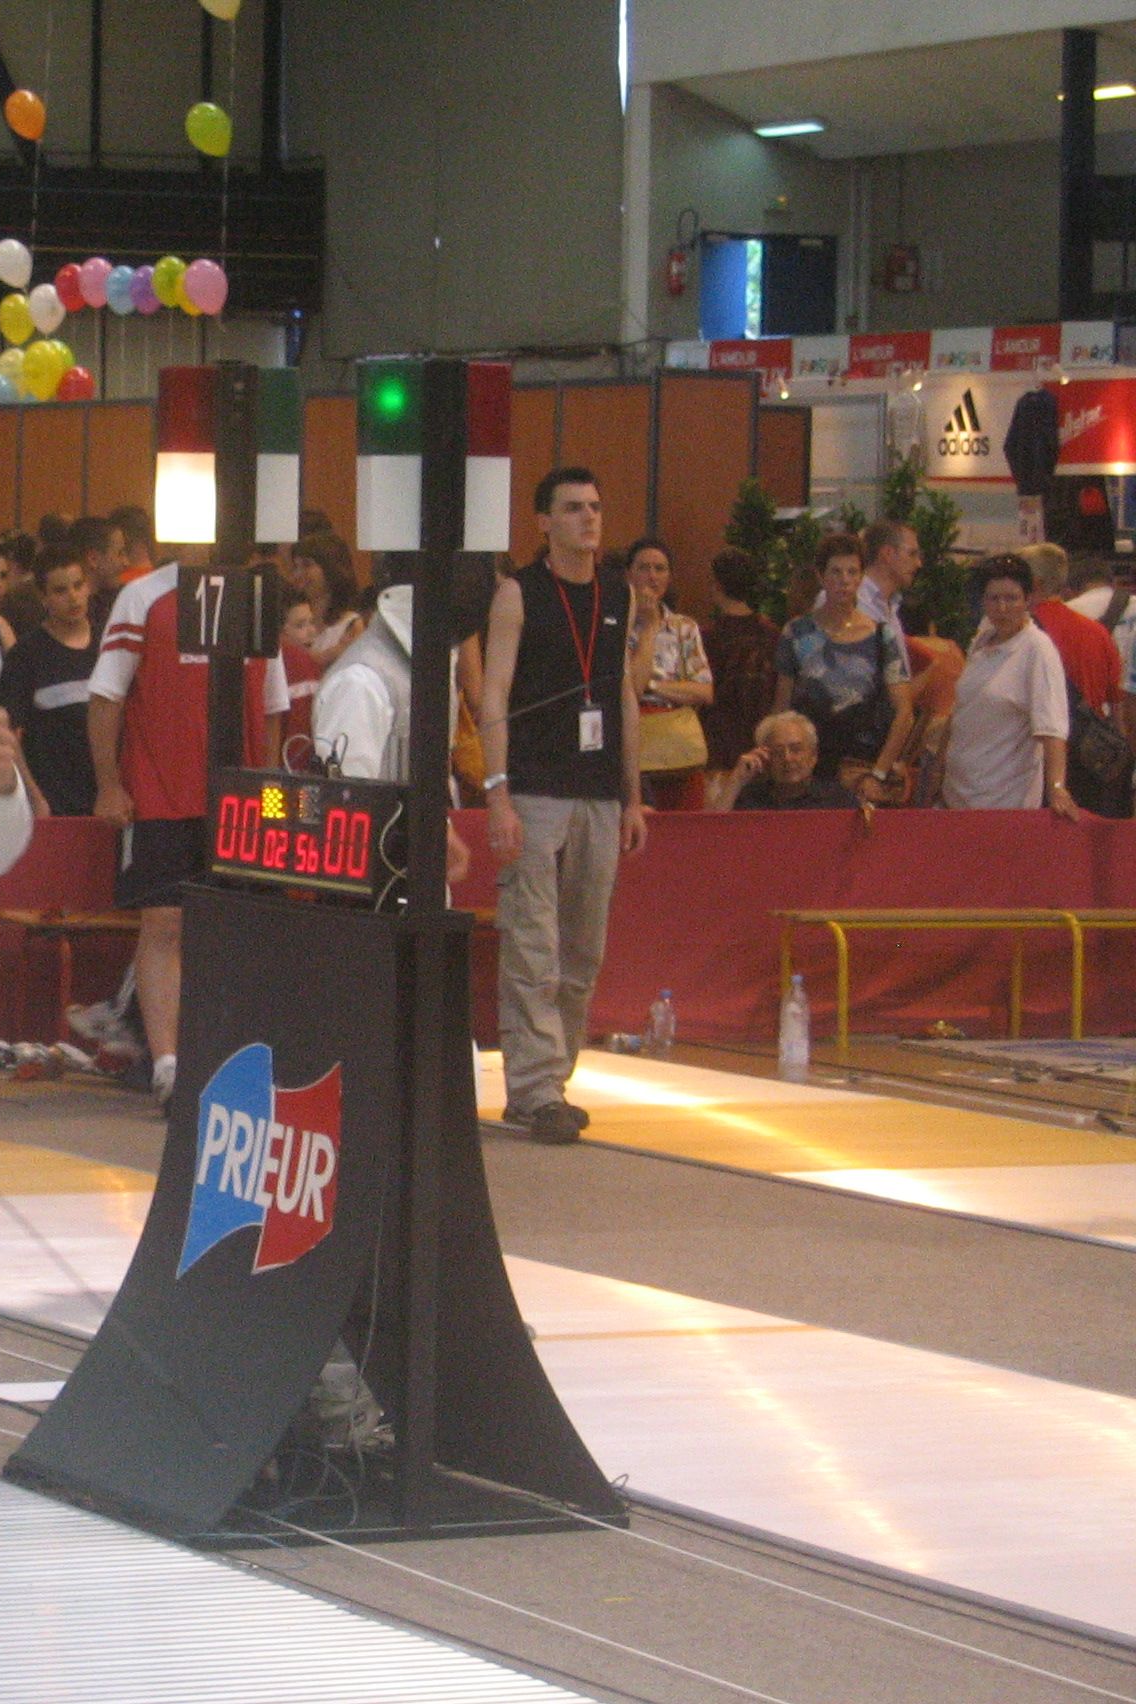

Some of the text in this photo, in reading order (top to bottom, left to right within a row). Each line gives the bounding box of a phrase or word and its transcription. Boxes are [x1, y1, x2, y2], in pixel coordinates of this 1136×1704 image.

[938, 435, 990, 457] adidas
[195, 575, 225, 646] 17
[217, 795, 261, 862] 00
[262, 828, 320, 874] 02 56
[323, 807, 372, 879] 00
[197, 1103, 337, 1222] PRIEUR
